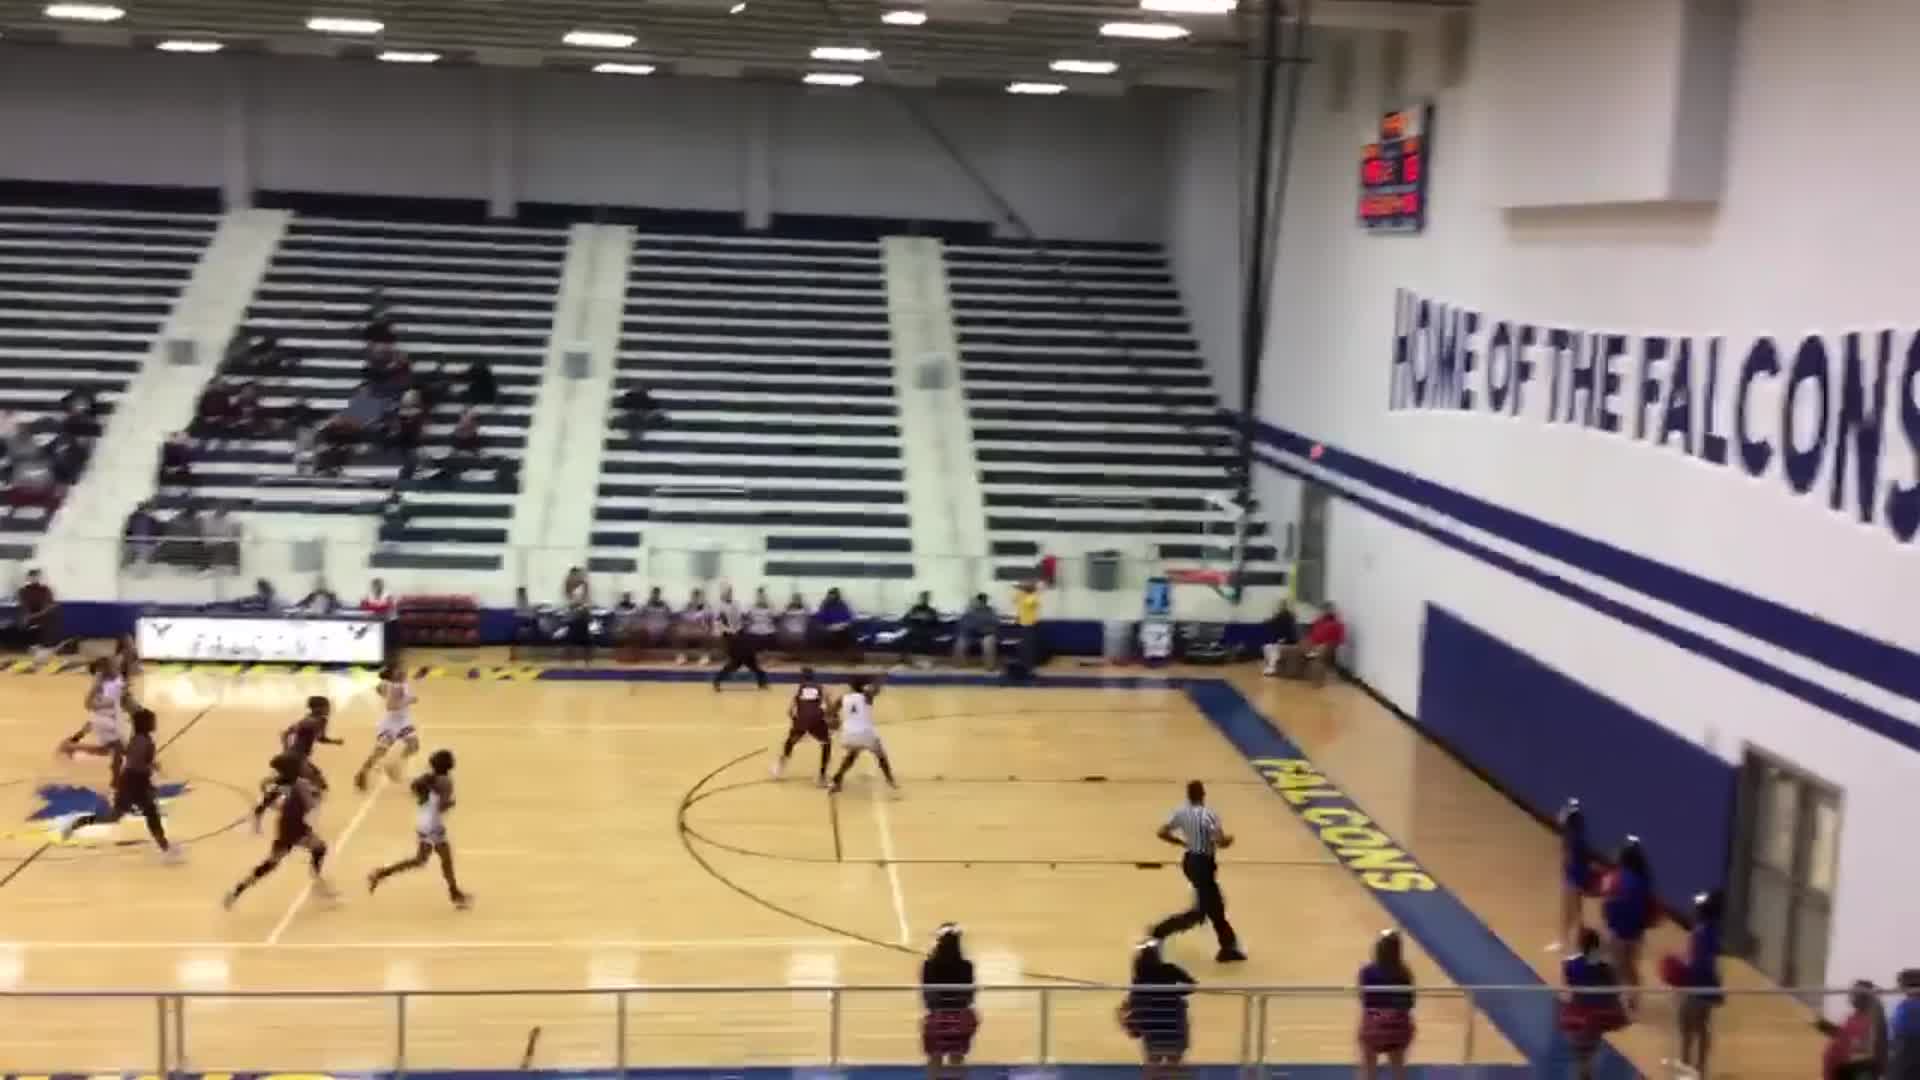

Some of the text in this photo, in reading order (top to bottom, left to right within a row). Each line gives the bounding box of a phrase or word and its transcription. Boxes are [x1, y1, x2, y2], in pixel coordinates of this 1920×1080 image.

[1390, 288, 1920, 543] HOME OF THE FALCONS
[1250, 758, 1437, 891] FALCONS
